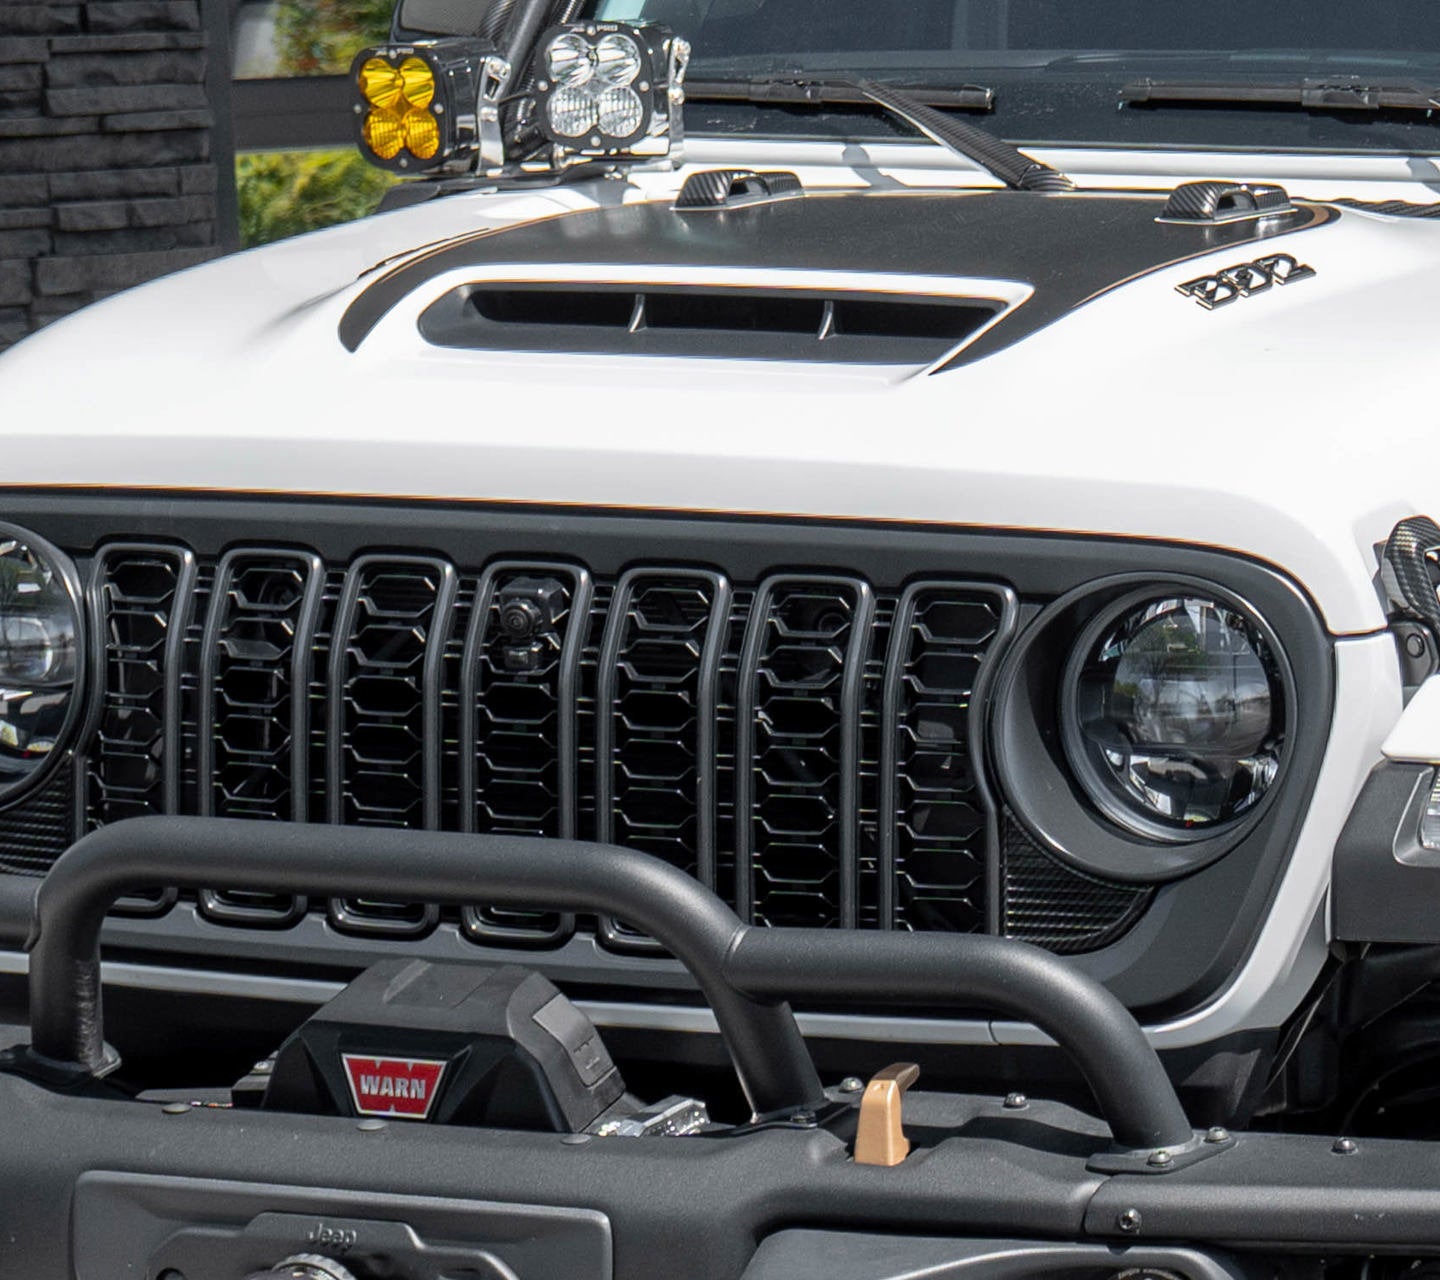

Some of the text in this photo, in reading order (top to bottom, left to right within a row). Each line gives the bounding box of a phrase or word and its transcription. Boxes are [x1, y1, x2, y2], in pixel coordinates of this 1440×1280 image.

[1174, 253, 1317, 310] 392
[360, 1074, 427, 1099] WARN
[306, 1223, 357, 1249] Jeep
